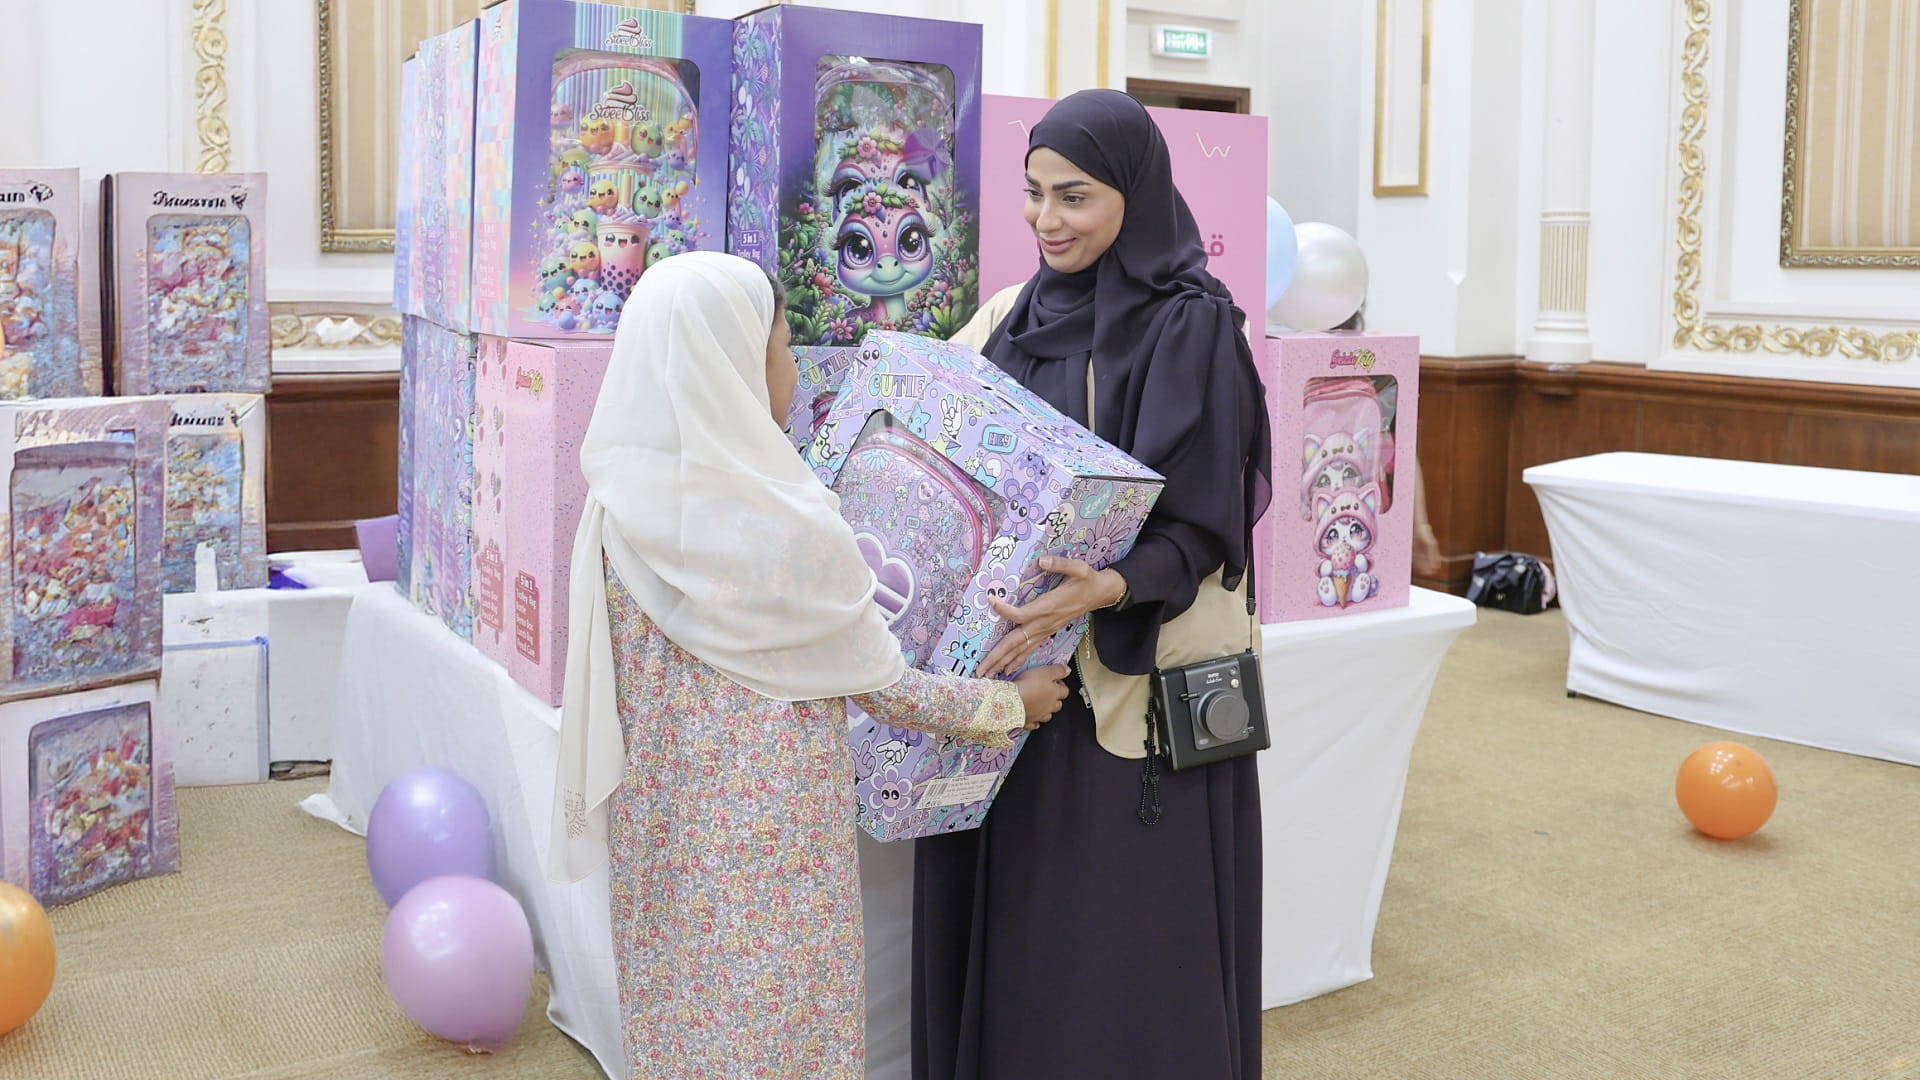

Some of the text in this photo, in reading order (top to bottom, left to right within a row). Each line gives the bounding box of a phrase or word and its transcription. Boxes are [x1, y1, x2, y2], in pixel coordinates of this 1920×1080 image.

[798, 350, 850, 390] CUTIE
[867, 373, 926, 401] CUTIE
[988, 431, 1011, 448] HEY
